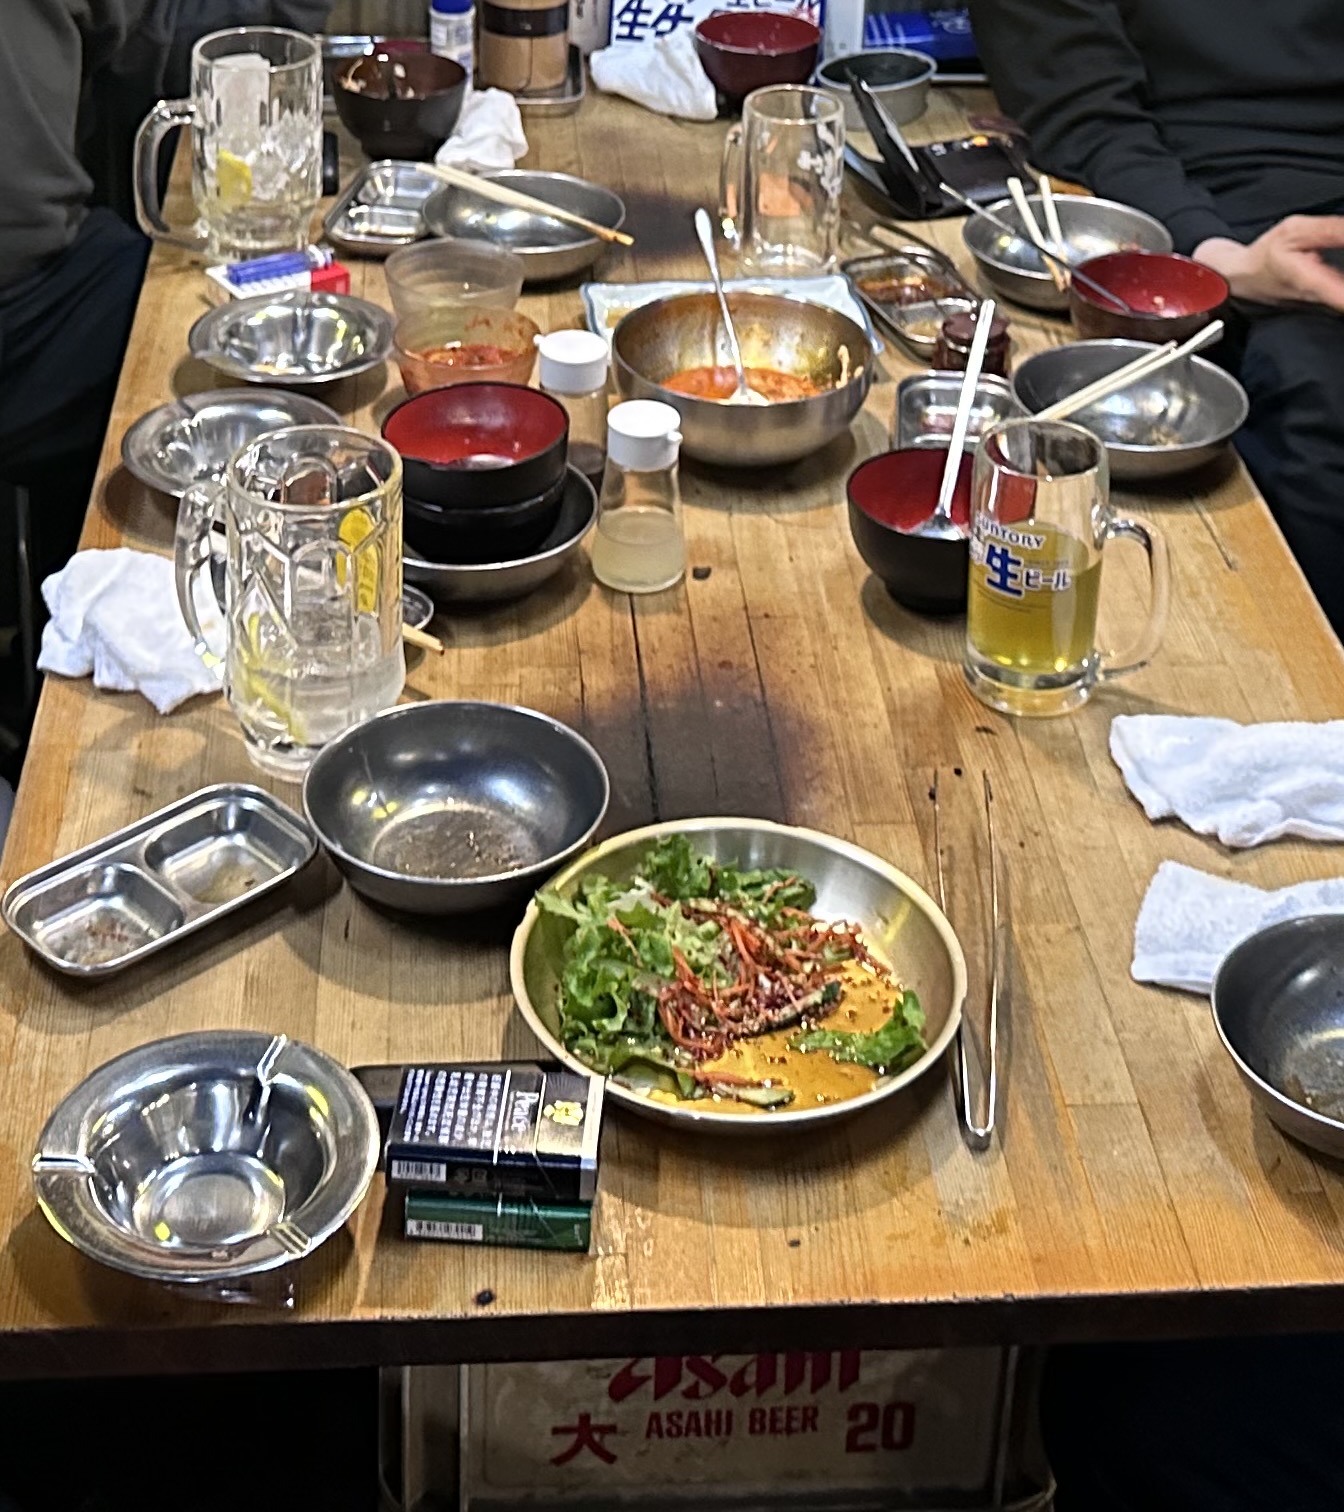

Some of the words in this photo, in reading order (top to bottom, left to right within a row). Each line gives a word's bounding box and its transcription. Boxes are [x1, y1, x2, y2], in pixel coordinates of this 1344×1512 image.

[510, 1090, 540, 1134] Peace
[550, 1412, 618, 1465] 大
[645, 1408, 734, 1441] ASAHI
[748, 1405, 819, 1438] BEER
[845, 1401, 916, 1454] 20
